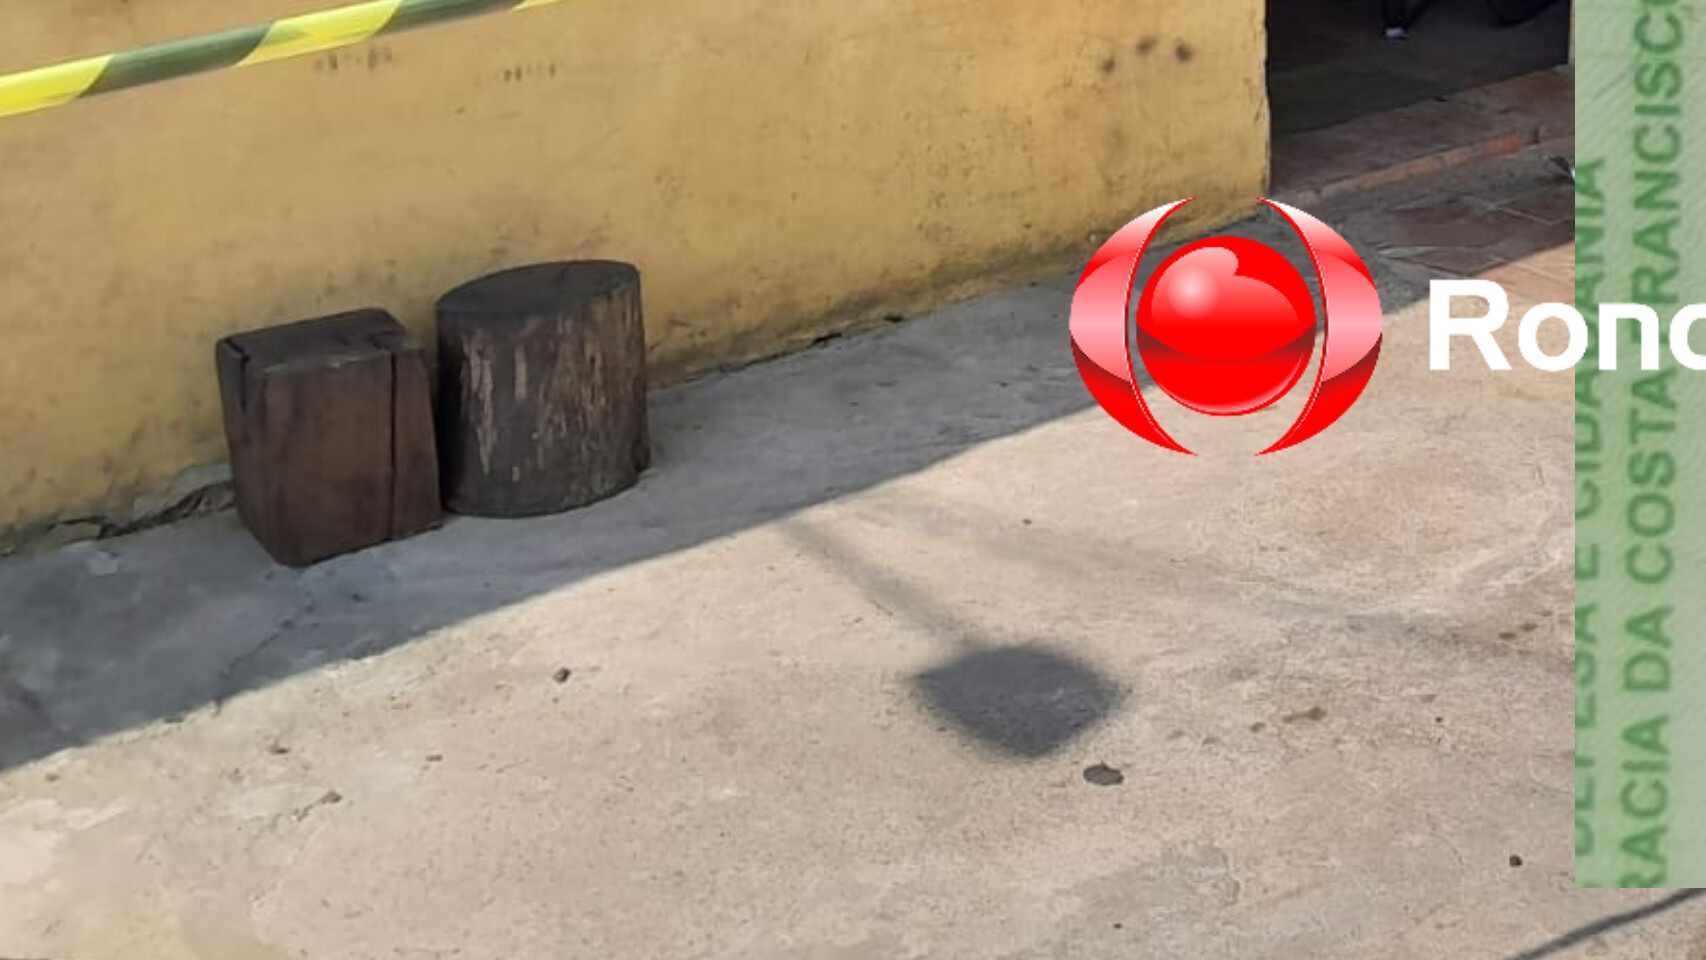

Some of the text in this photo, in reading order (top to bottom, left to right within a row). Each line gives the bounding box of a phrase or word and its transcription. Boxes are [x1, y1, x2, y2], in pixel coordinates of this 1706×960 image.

[1575, 158, 1604, 520] CIDAANIA
[1625, 367, 1678, 584] COSTA
[1622, 604, 1675, 692] DA
